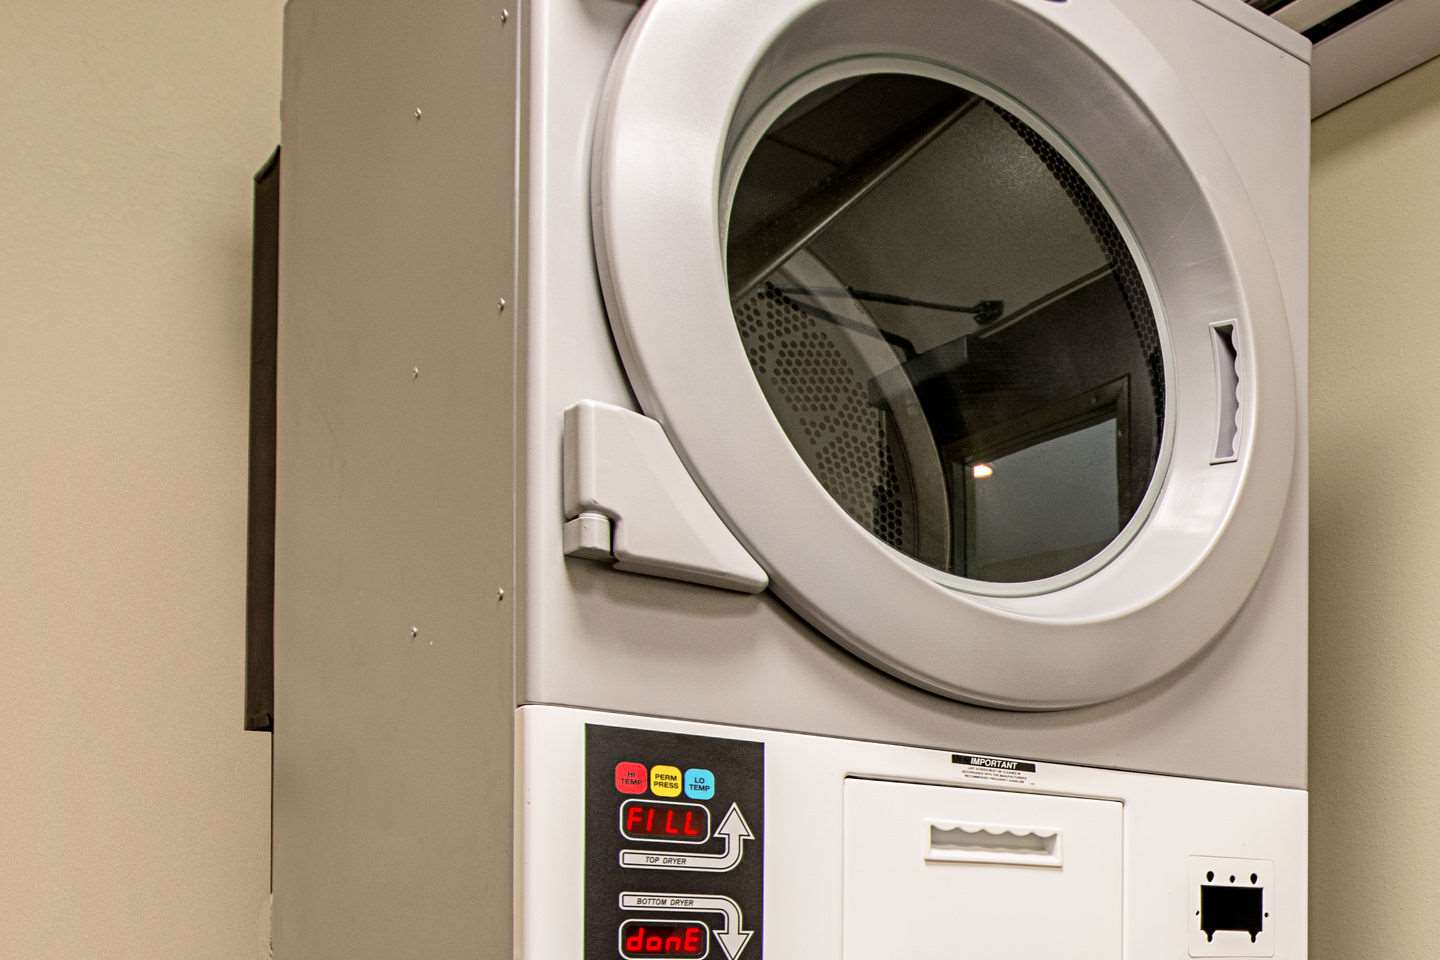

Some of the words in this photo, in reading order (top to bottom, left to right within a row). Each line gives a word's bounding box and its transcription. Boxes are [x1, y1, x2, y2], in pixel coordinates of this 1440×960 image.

[970, 757, 1018, 769] IMPORTANT
[655, 773, 677, 781] PERM
[654, 781, 679, 790] PRESS
[689, 784, 710, 792] TEMP
[627, 806, 699, 836] FILL
[663, 857, 687, 865] DRYER
[637, 898, 667, 906] BOTTOM
[670, 899, 694, 907] DRYER
